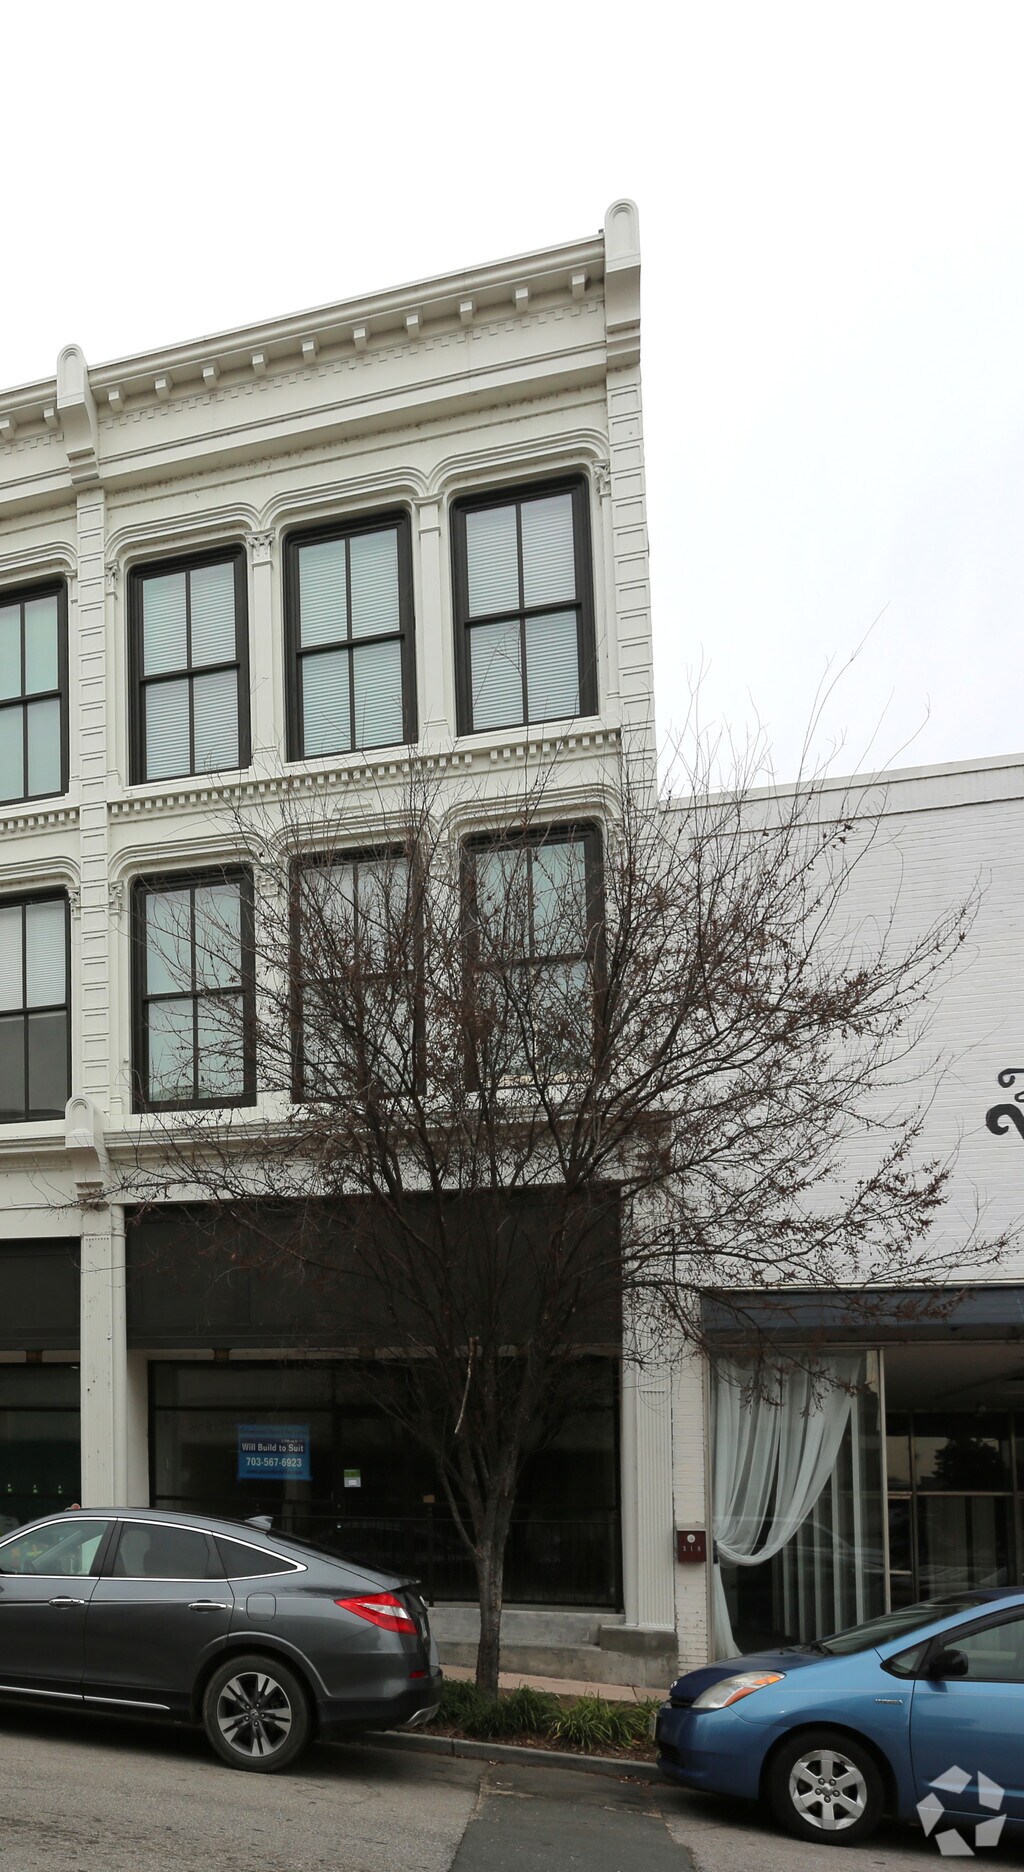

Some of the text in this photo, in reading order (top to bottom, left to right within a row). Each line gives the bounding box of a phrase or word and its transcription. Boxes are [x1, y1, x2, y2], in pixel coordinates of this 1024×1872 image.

[258, 1443, 276, 1451] Build
[288, 1444, 304, 1452] Suit
[246, 1457, 302, 1467] 703-567-6923
